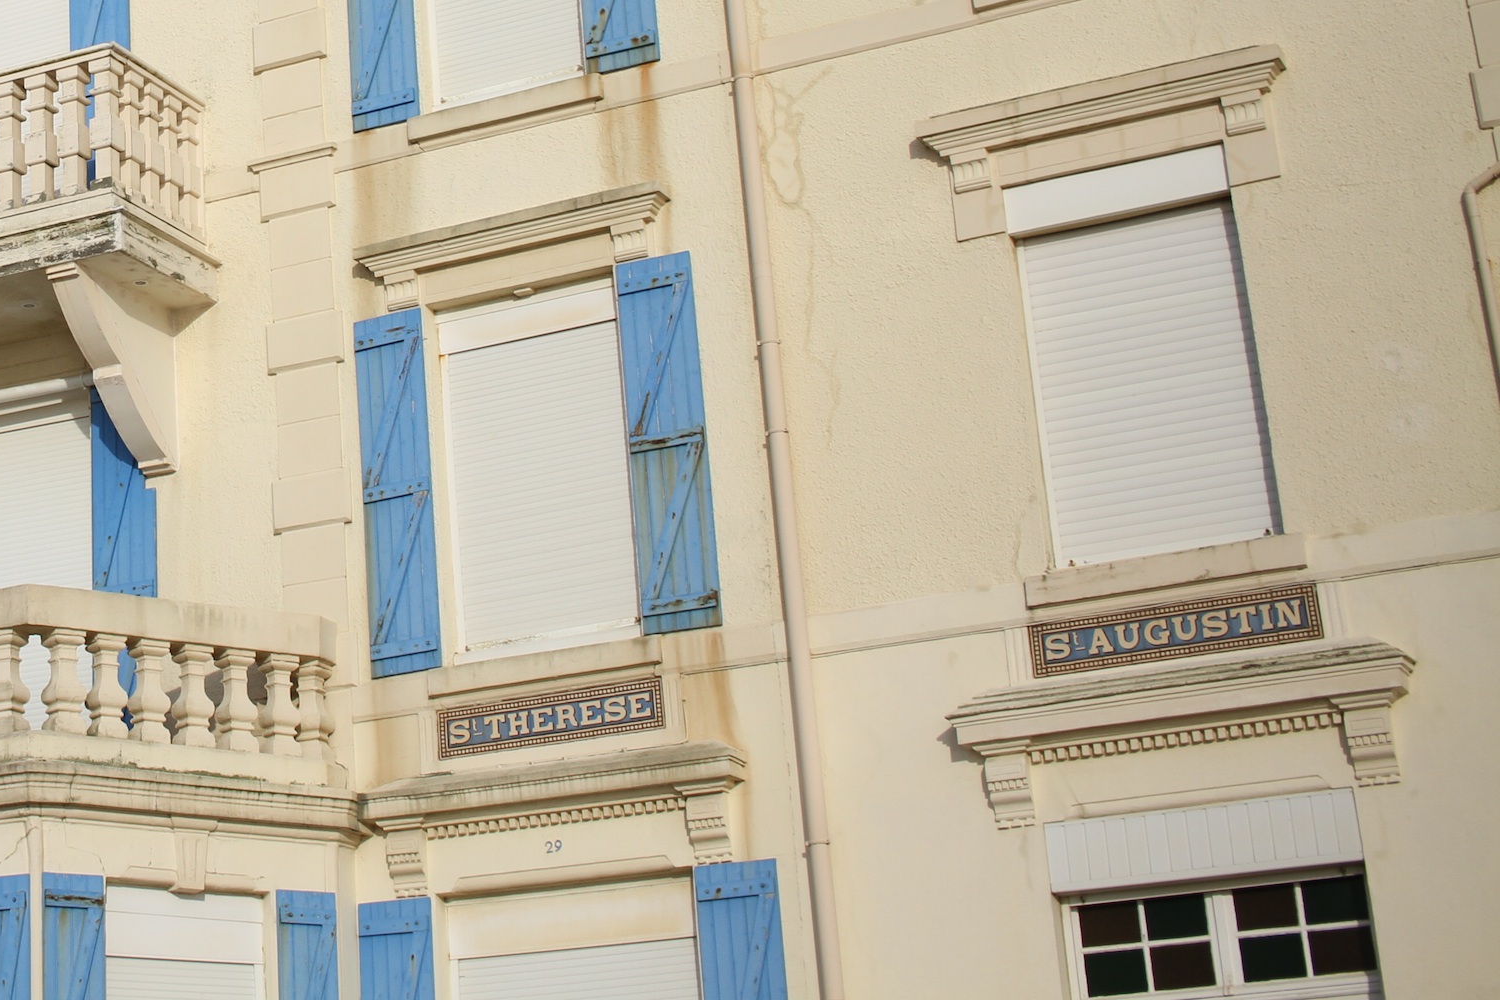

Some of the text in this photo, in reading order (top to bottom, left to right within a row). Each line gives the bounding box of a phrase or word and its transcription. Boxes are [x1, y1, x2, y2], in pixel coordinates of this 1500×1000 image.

[1089, 600, 1303, 655] AUGUSTIN
[484, 692, 652, 740] THERESE
[544, 839, 563, 854] 29
